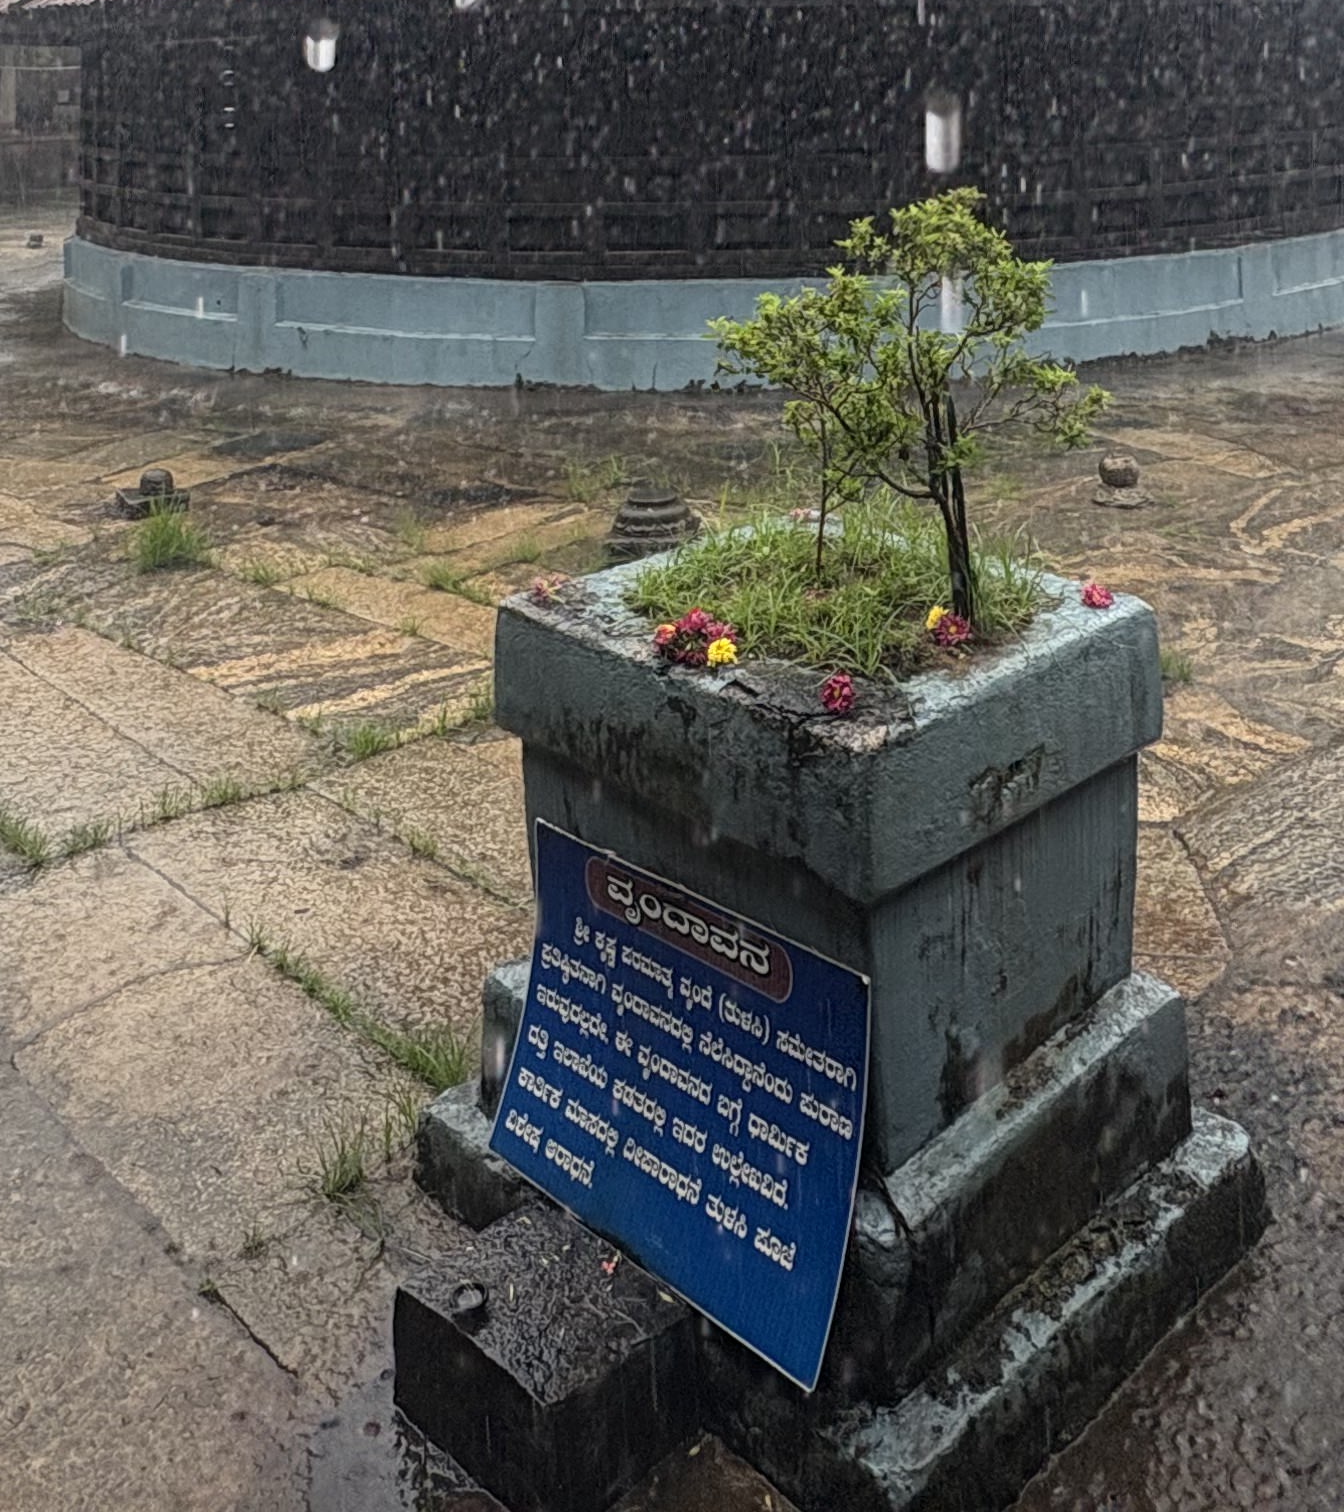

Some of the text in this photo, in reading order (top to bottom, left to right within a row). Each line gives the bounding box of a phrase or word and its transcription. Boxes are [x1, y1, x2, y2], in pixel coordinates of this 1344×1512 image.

[607, 875, 770, 974] ವೃಂದಾವನ
[573, 916, 857, 1091] ಶ್ರೀ ಕೃಷ್ಣ ಪರಮಾತ್ಮ ವೃಂದೆ (ತುಳಸಿ) ಸಮೇತರಾಗಿ
[611, 983, 694, 1053] ವೃಂದಾವನದಲ್ಲಿ
[698, 1031, 793, 1104] ನೆಲೆಸಿದ್ದಾನೆಂದು
[799, 1092, 853, 1140] ಪುರಾಣ
[505, 1108, 544, 1153] ವಿಶೇಷ
[517, 1066, 797, 1271] ಕಾರ್ತಿಕ ಮಾಸದಲ್ಲಿ ದೀಪಾರಾಧನೆ ತುಳಸಿ ಪೂಜೆ
[527, 1024, 789, 1210] ದತ್ತಿ ಇಲಾಖೆಯ ಕಡತದಲ್ಲಿ ಇದರ ಉಲ್ಲೇಖವಿದೆ.
[615, 1031, 633, 1057] ಈ
[637, 1044, 713, 1105] ವೃಂದಾವನದ
[716, 1094, 743, 1137] ಬಗ್ಗೆ
[747, 1112, 810, 1166] ಧಾರ್ಮಿಕ
